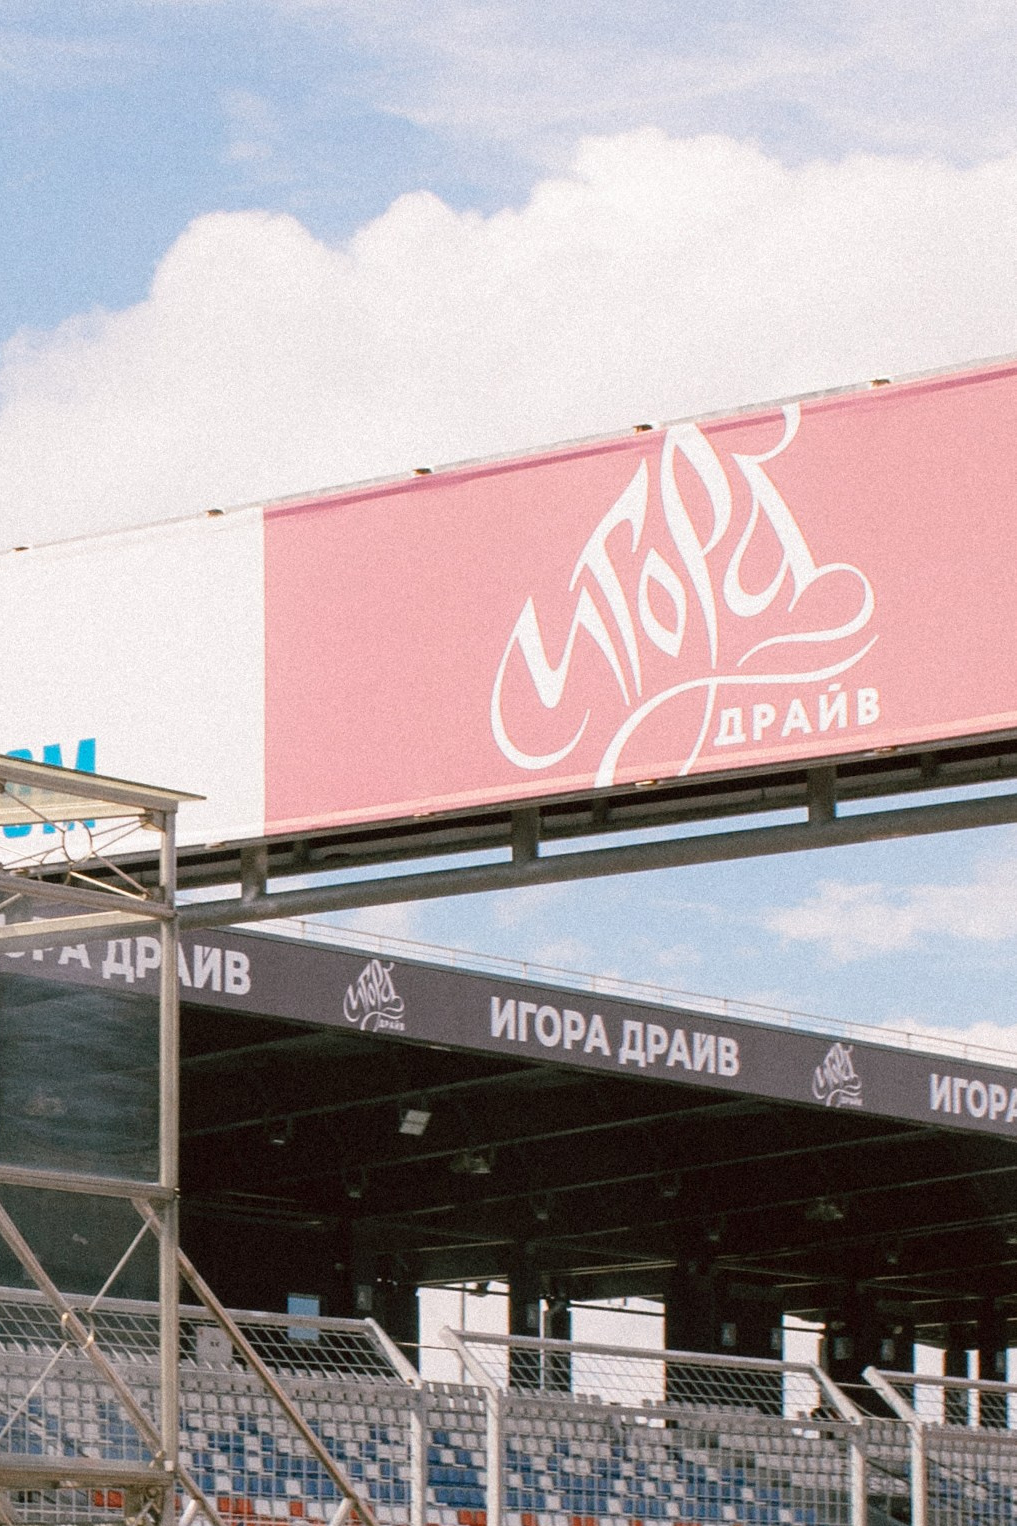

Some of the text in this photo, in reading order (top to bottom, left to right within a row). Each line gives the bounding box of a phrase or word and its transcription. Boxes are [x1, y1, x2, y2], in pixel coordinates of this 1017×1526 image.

[714, 684, 881, 747] ДРАЙВ
[491, 996, 740, 1077] ИГОРА ДРАЙВ
